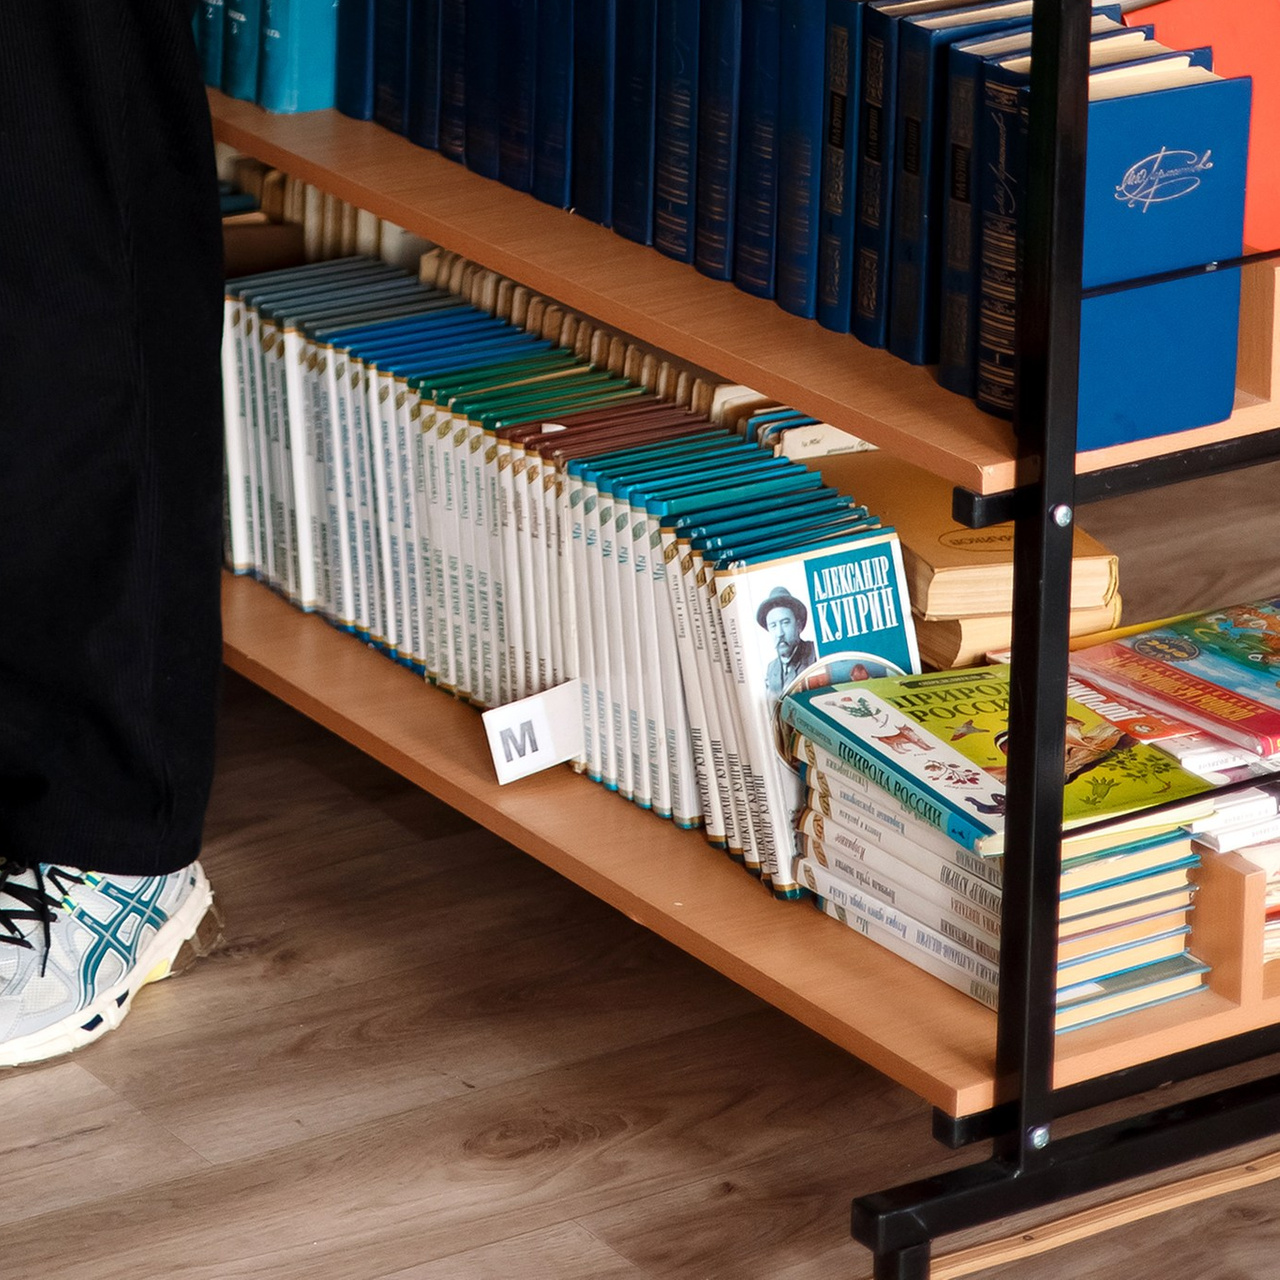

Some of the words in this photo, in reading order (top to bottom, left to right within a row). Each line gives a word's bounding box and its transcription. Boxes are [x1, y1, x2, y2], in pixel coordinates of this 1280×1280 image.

[586, 528, 597, 547] Мы
[602, 540, 612, 559] Мы
[618, 546, 628, 564] Мы
[635, 554, 646, 574] Мы
[653, 562, 665, 582] Мы
[813, 555, 889, 602] АЛЕКСАНДР
[815, 587, 899, 644] КУПРИН
[498, 719, 540, 763] М
[692, 727, 705, 768] КУПРИН
[711, 740, 726, 780] КУПРИН
[729, 753, 742, 794] КУПРИН
[838, 741, 891, 792] ПРИРОДА
[894, 780, 942, 828] РОССИИ
[695, 771, 714, 829] АЛЕКСАНДР
[719, 782, 737, 841] АЛЕКСАНДР
[755, 775, 769, 816] КУПРИН
[735, 796, 753, 855] АЛЕКСАНДР
[760, 819, 780, 878] АЛЕКСАНДР
[939, 865, 970, 897] КУПРИН
